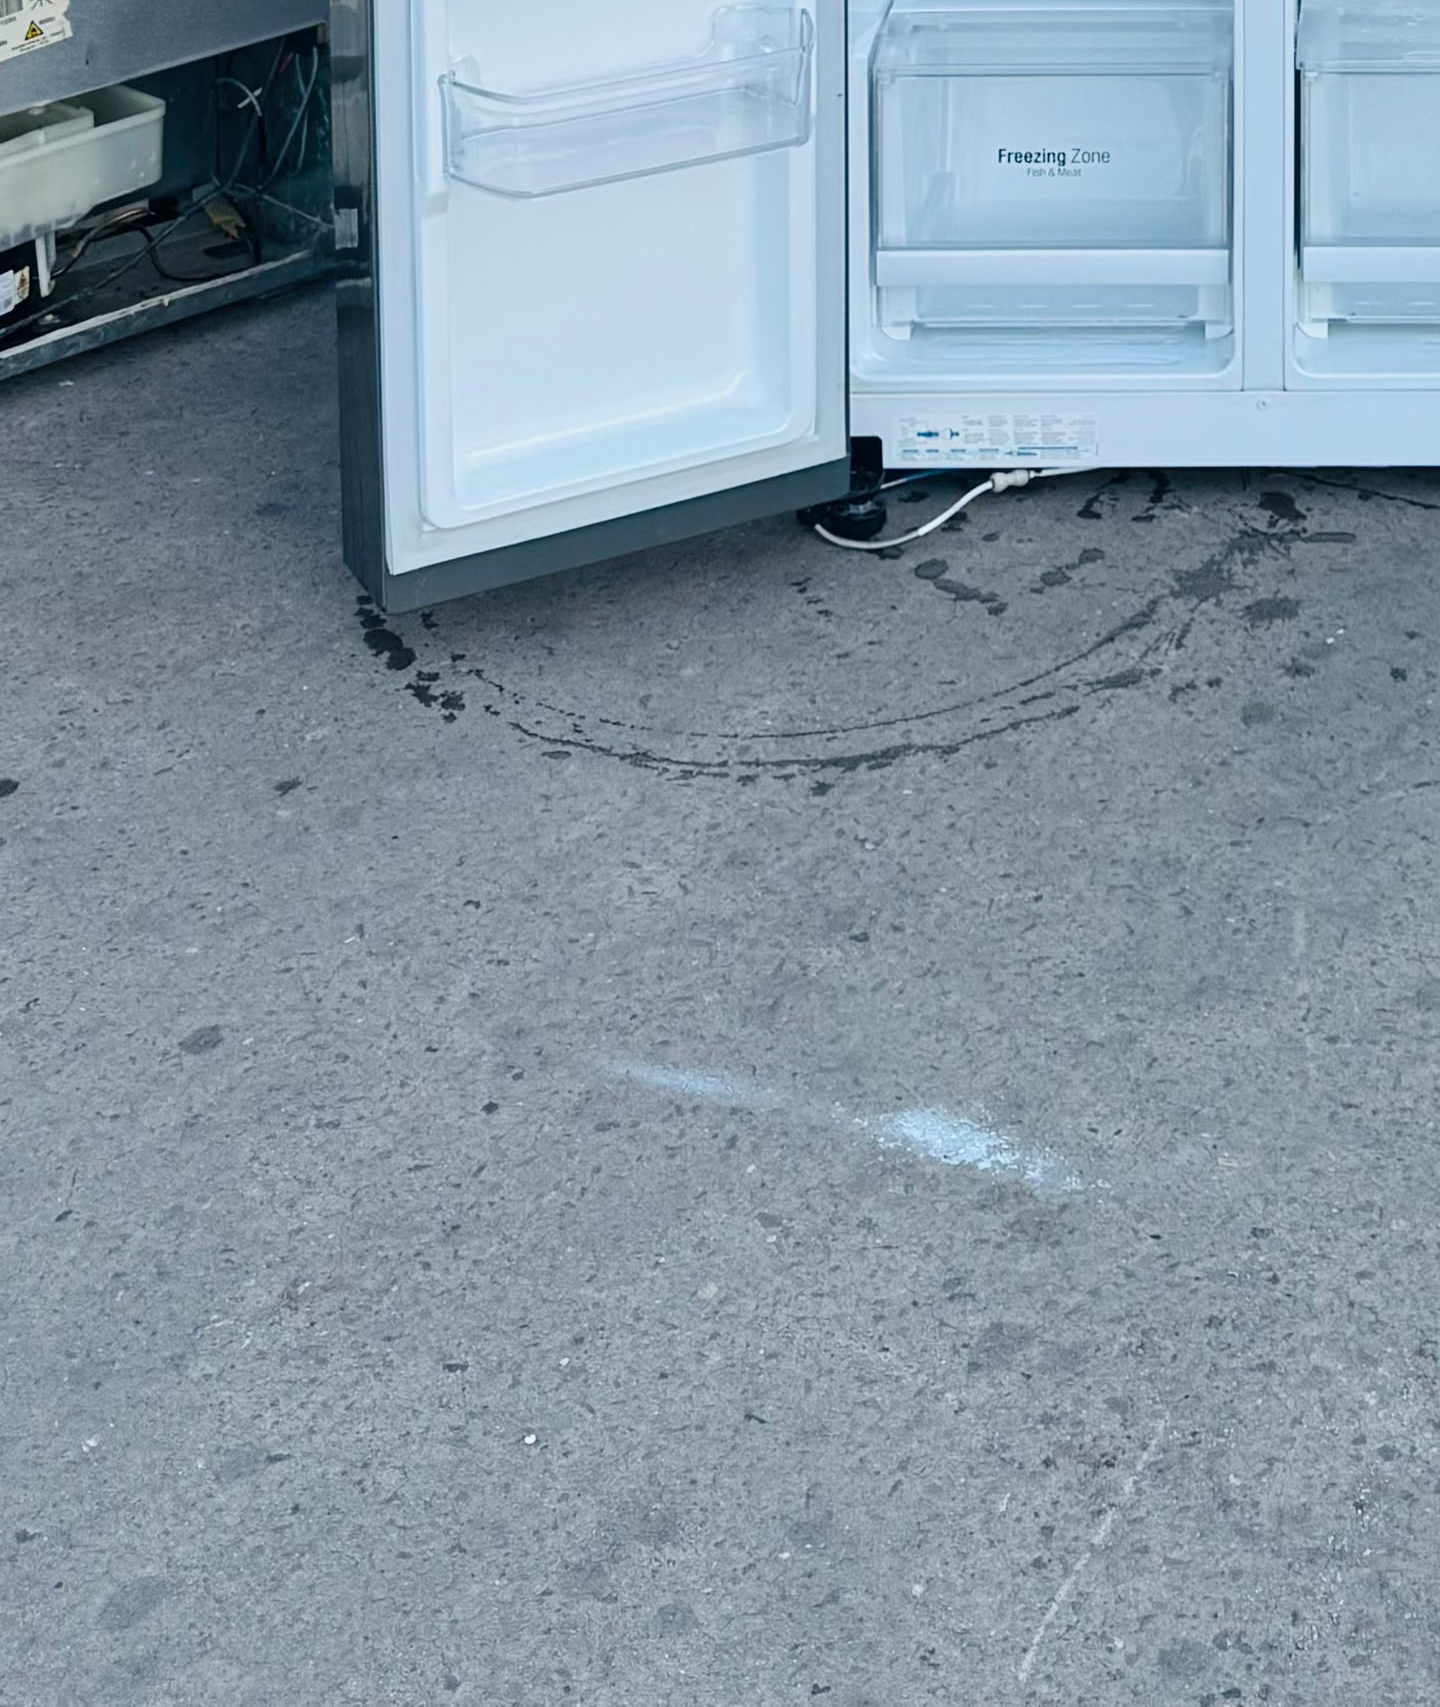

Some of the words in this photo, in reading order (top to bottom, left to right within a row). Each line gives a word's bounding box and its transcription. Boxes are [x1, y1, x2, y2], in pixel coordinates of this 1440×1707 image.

[999, 148, 1067, 167] Freezing
[1071, 148, 1111, 164] Zone
[1026, 167, 1047, 177] Fish
[1048, 168, 1056, 177] &
[1057, 168, 1082, 177] Meat
